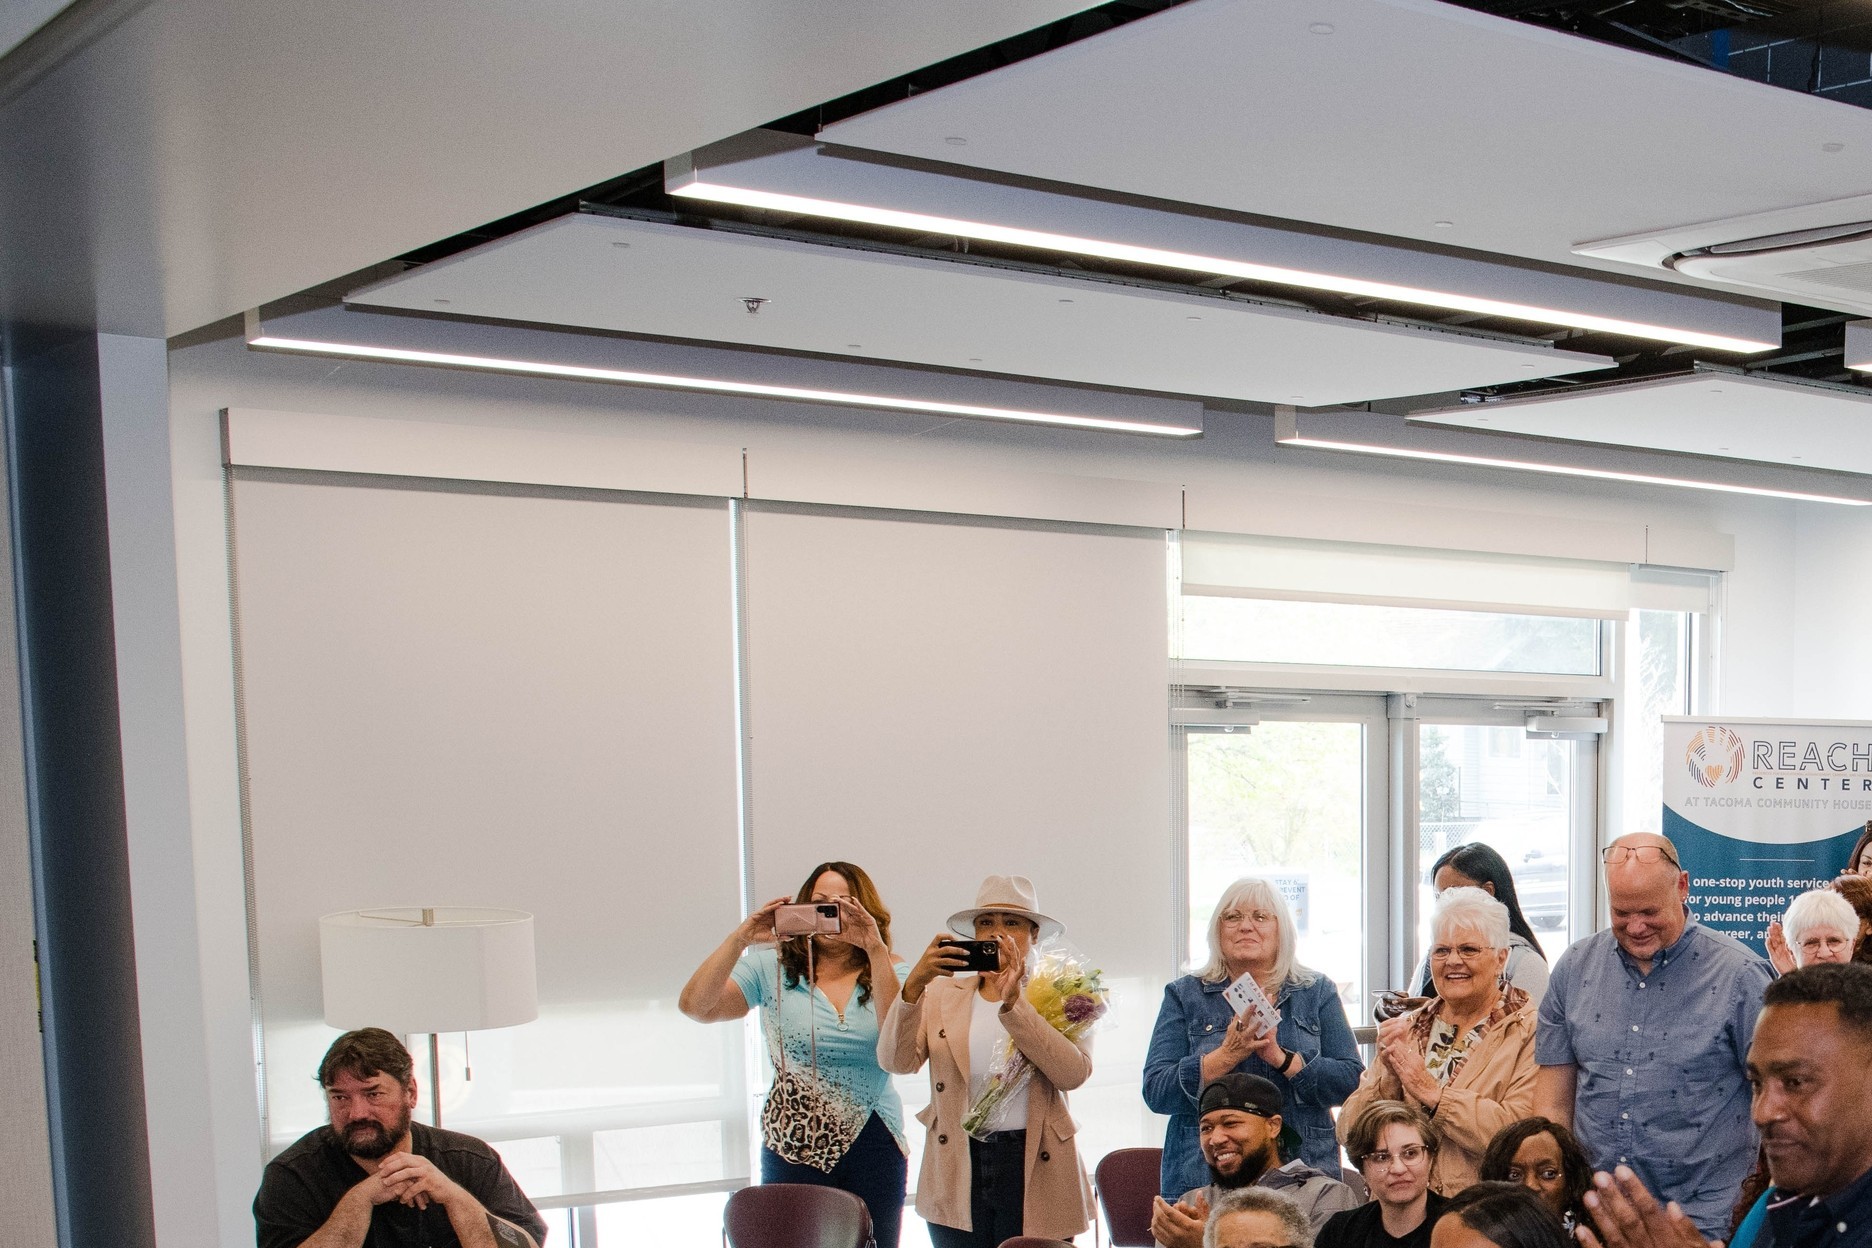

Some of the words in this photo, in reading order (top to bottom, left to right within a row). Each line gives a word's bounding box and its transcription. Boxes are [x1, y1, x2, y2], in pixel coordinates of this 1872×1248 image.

[1752, 776, 1872, 792] CENTER
[1684, 796, 1700, 808] AT
[1703, 796, 1752, 808] TACOMA
[1757, 797, 1829, 811] COMMUNITY
[1832, 798, 1872, 811] HOUSE
[1692, 877, 1746, 889] one-stop
[1749, 877, 1784, 890] youth
[1704, 895, 1742, 908] young
[1744, 894, 1786, 907] people
[1703, 911, 1754, 922] advance
[1720, 931, 1754, 941] areer,
